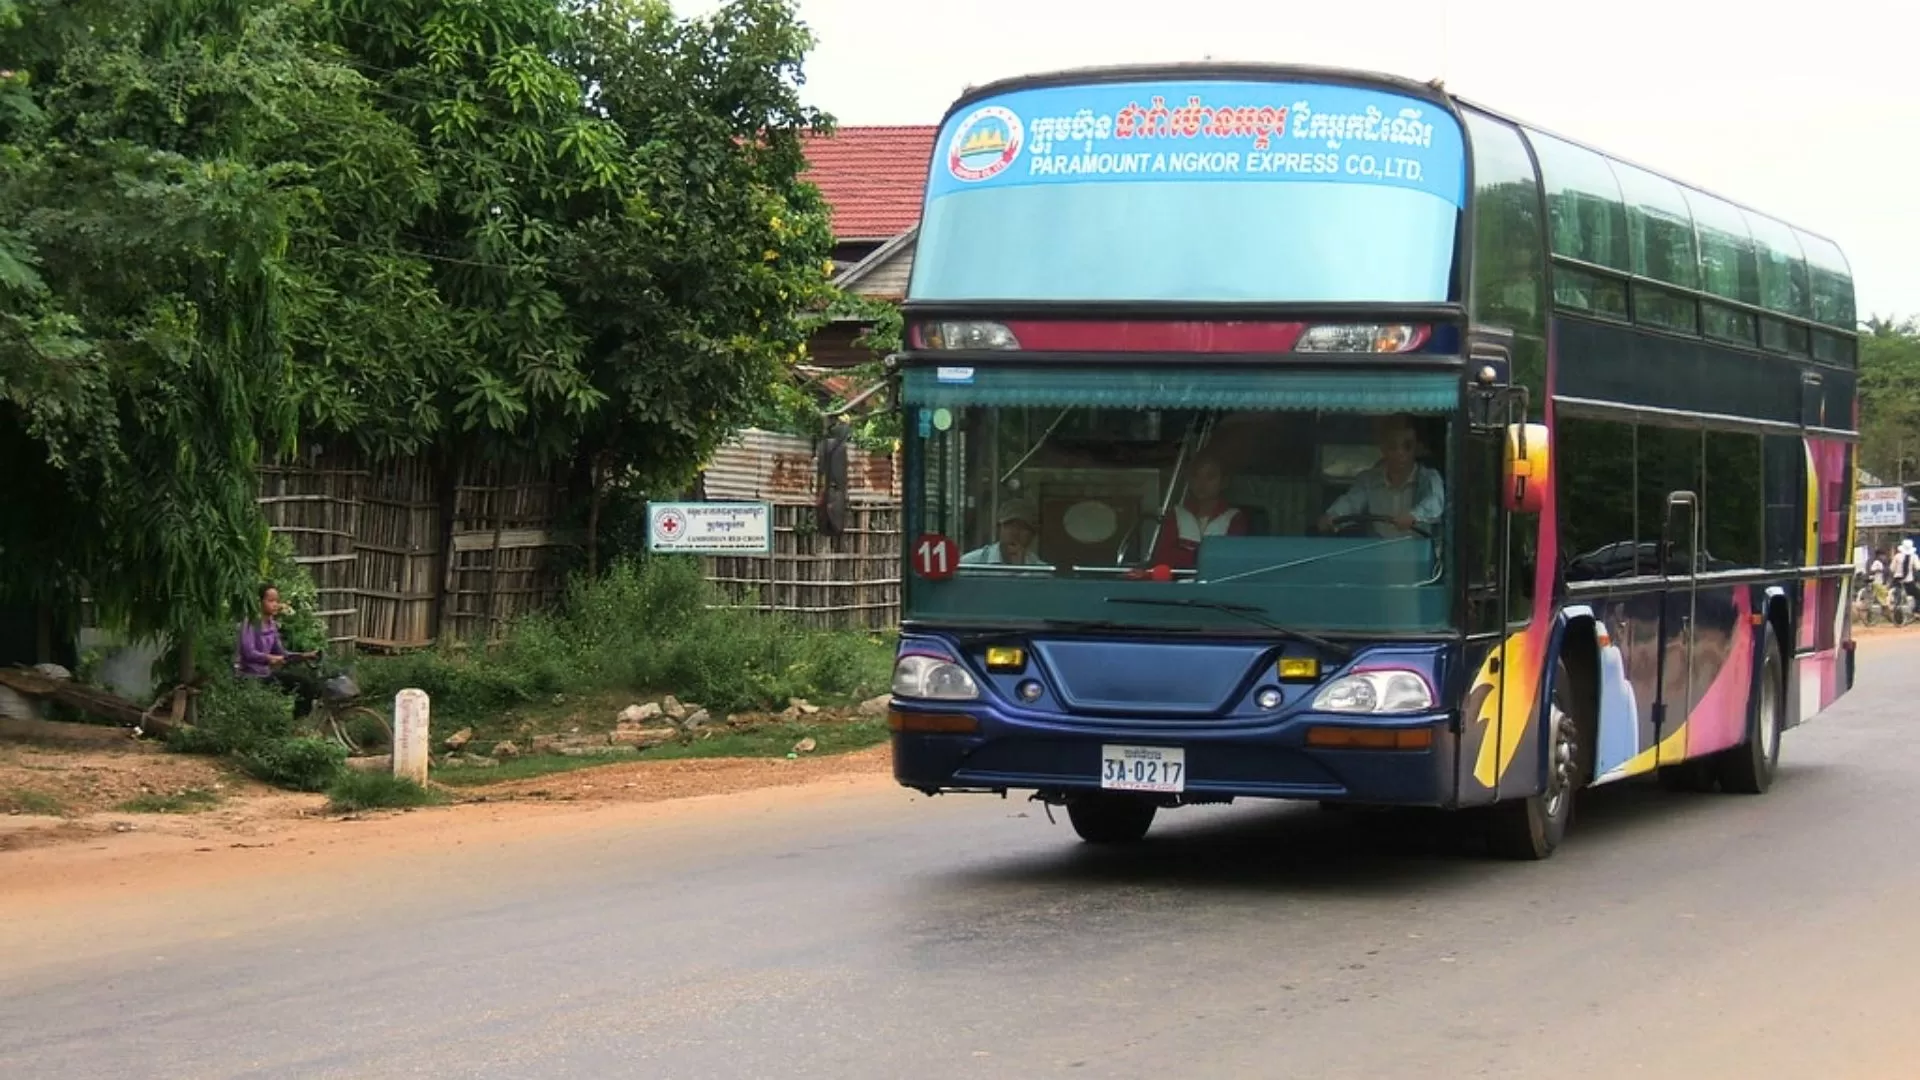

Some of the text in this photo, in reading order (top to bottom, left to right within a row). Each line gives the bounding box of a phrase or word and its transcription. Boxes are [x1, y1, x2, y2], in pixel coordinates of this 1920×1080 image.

[1029, 153, 1151, 176] PARAMOUNT
[1246, 152, 1340, 174] EXPRESS
[918, 541, 948, 573] 11
[1104, 759, 1182, 784] 3A-0217
